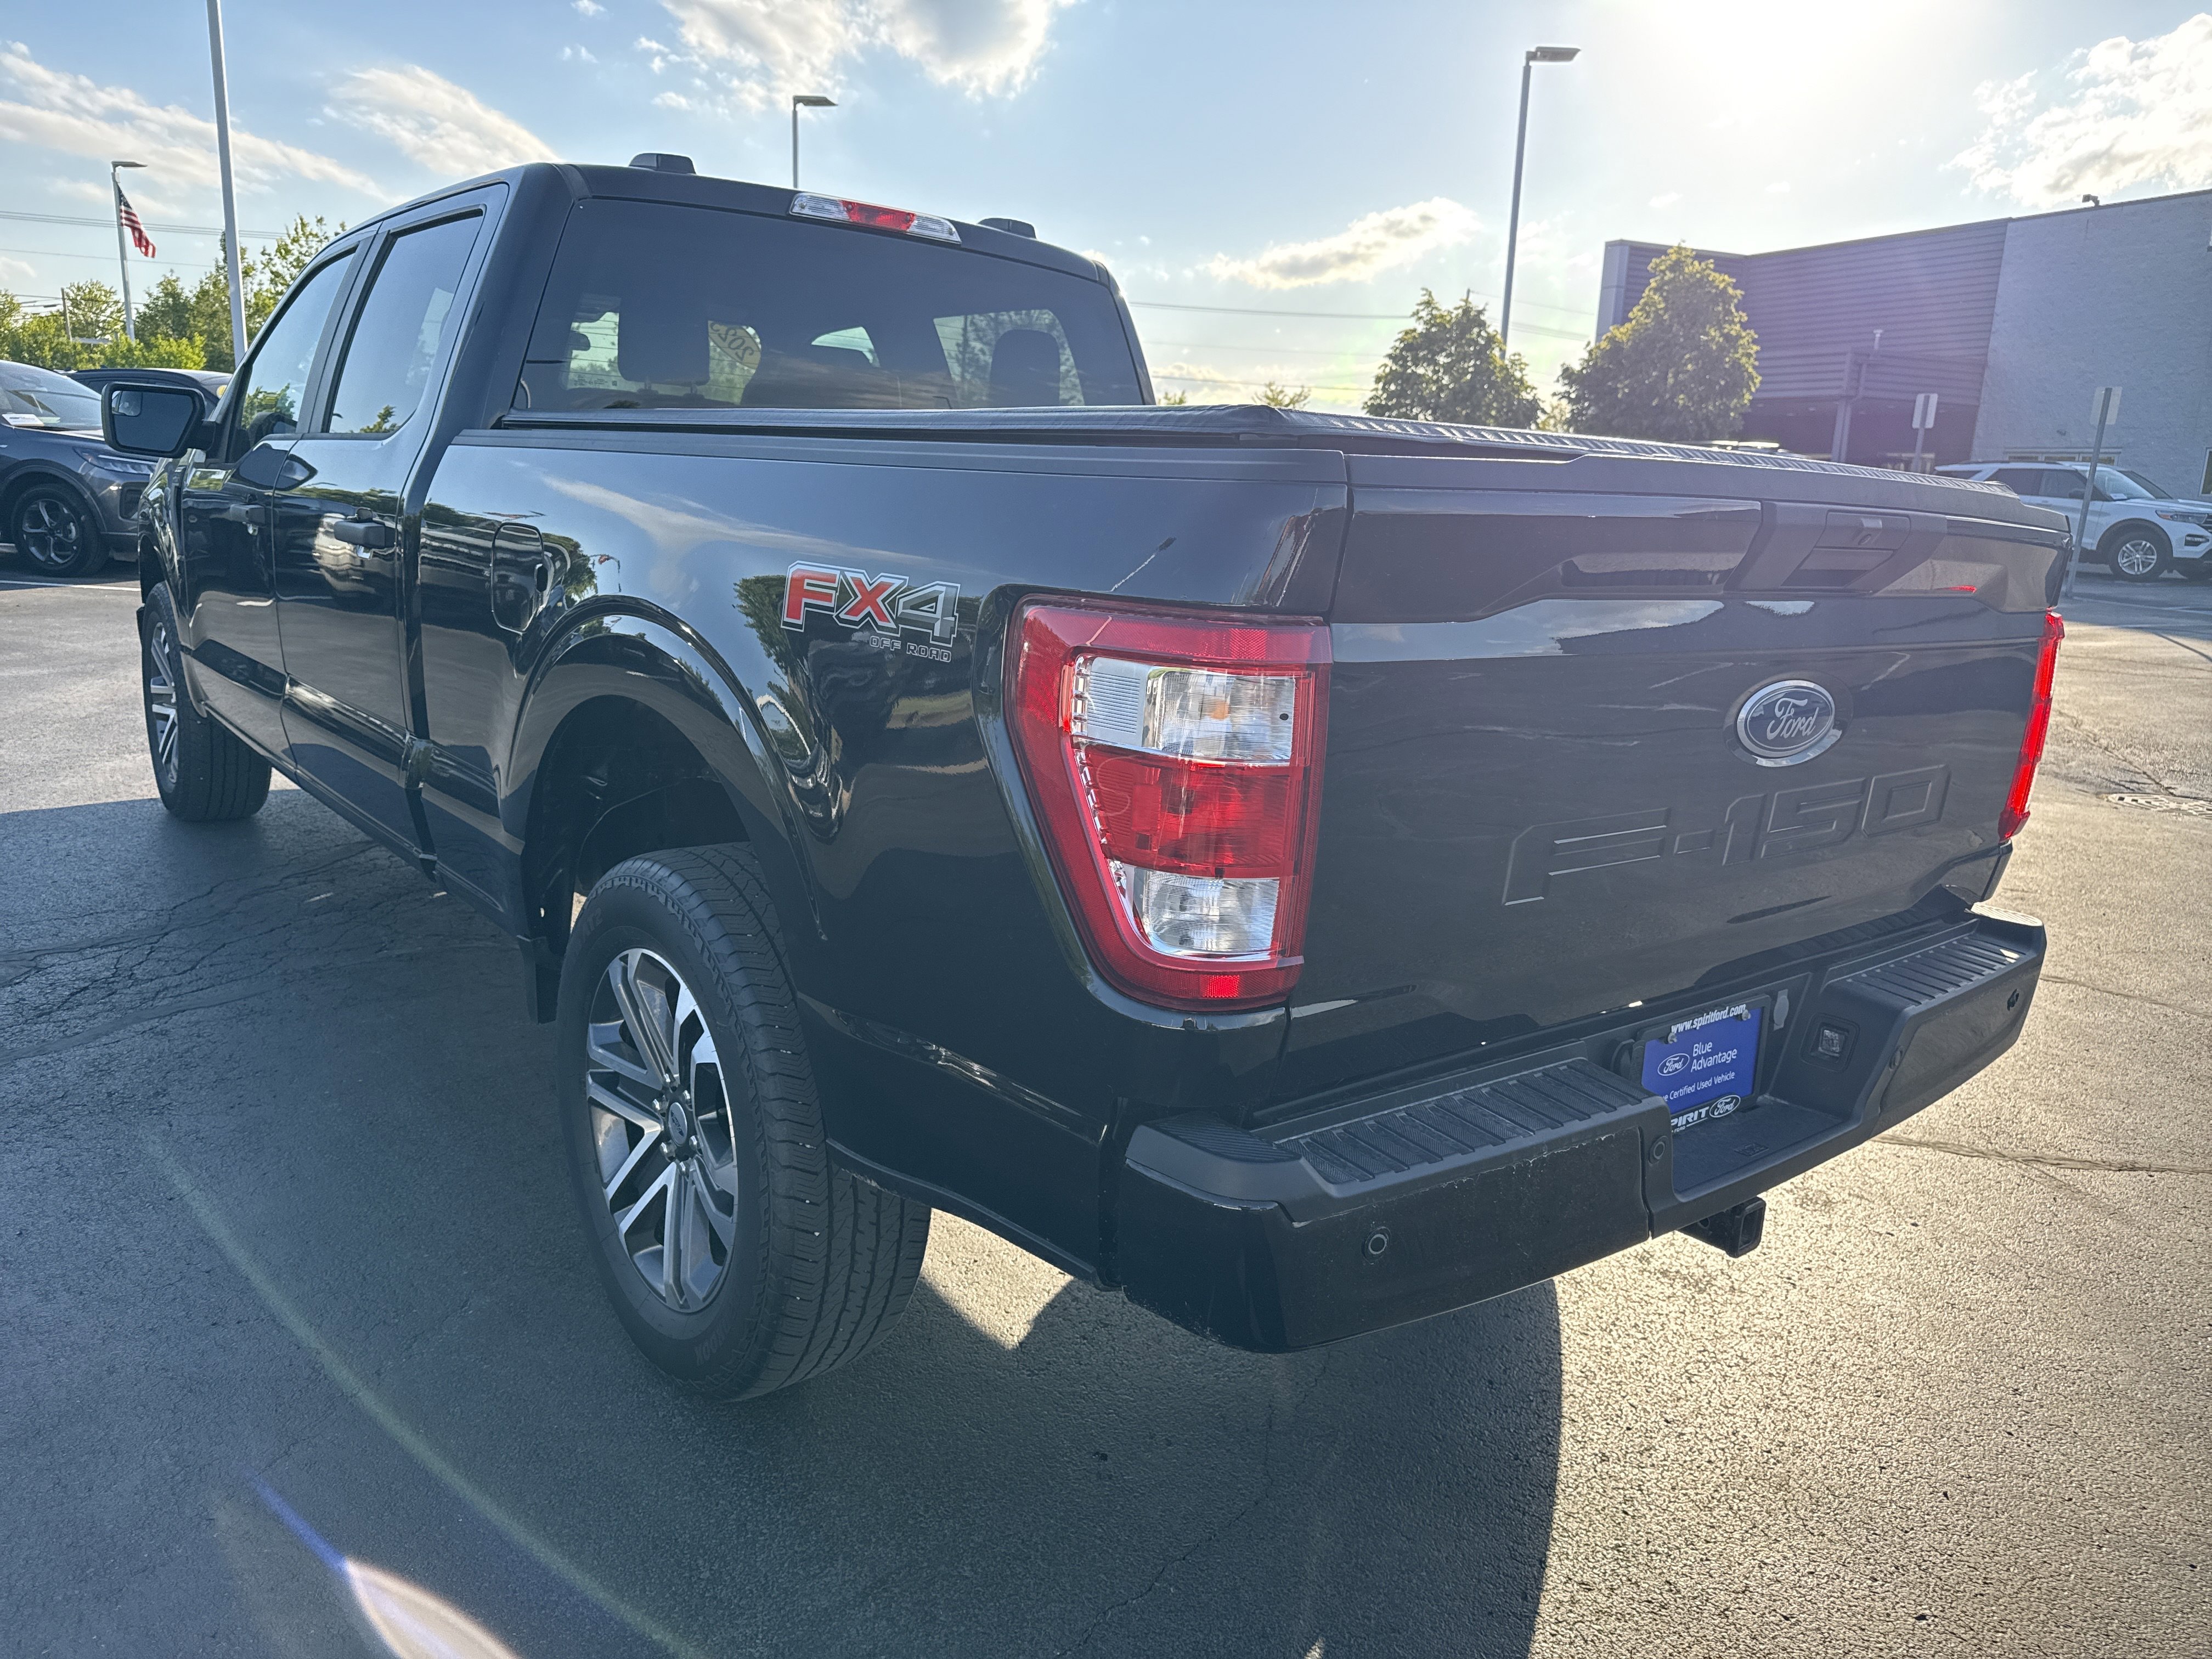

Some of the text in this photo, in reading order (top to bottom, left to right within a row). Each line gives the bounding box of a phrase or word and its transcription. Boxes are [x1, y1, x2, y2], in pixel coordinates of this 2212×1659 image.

[780, 560, 961, 647] FX4
[870, 636, 951, 662] OFF ROAD
[1767, 698, 1819, 740] Ford
[1502, 764, 1951, 906] F-150
[1671, 1003, 1746, 1034] www.spiritford.com
[1691, 1048, 1737, 1073] Advantage
[1692, 1042, 1712, 1057] Blue
[1663, 1057, 1684, 1074] Ford
[1669, 1083, 1695, 1100] Certified
[1697, 1077, 1712, 1091] Used
[1714, 1071, 1735, 1085] Vehicle
[1671, 1098, 1735, 1126] PIRIT Ford
